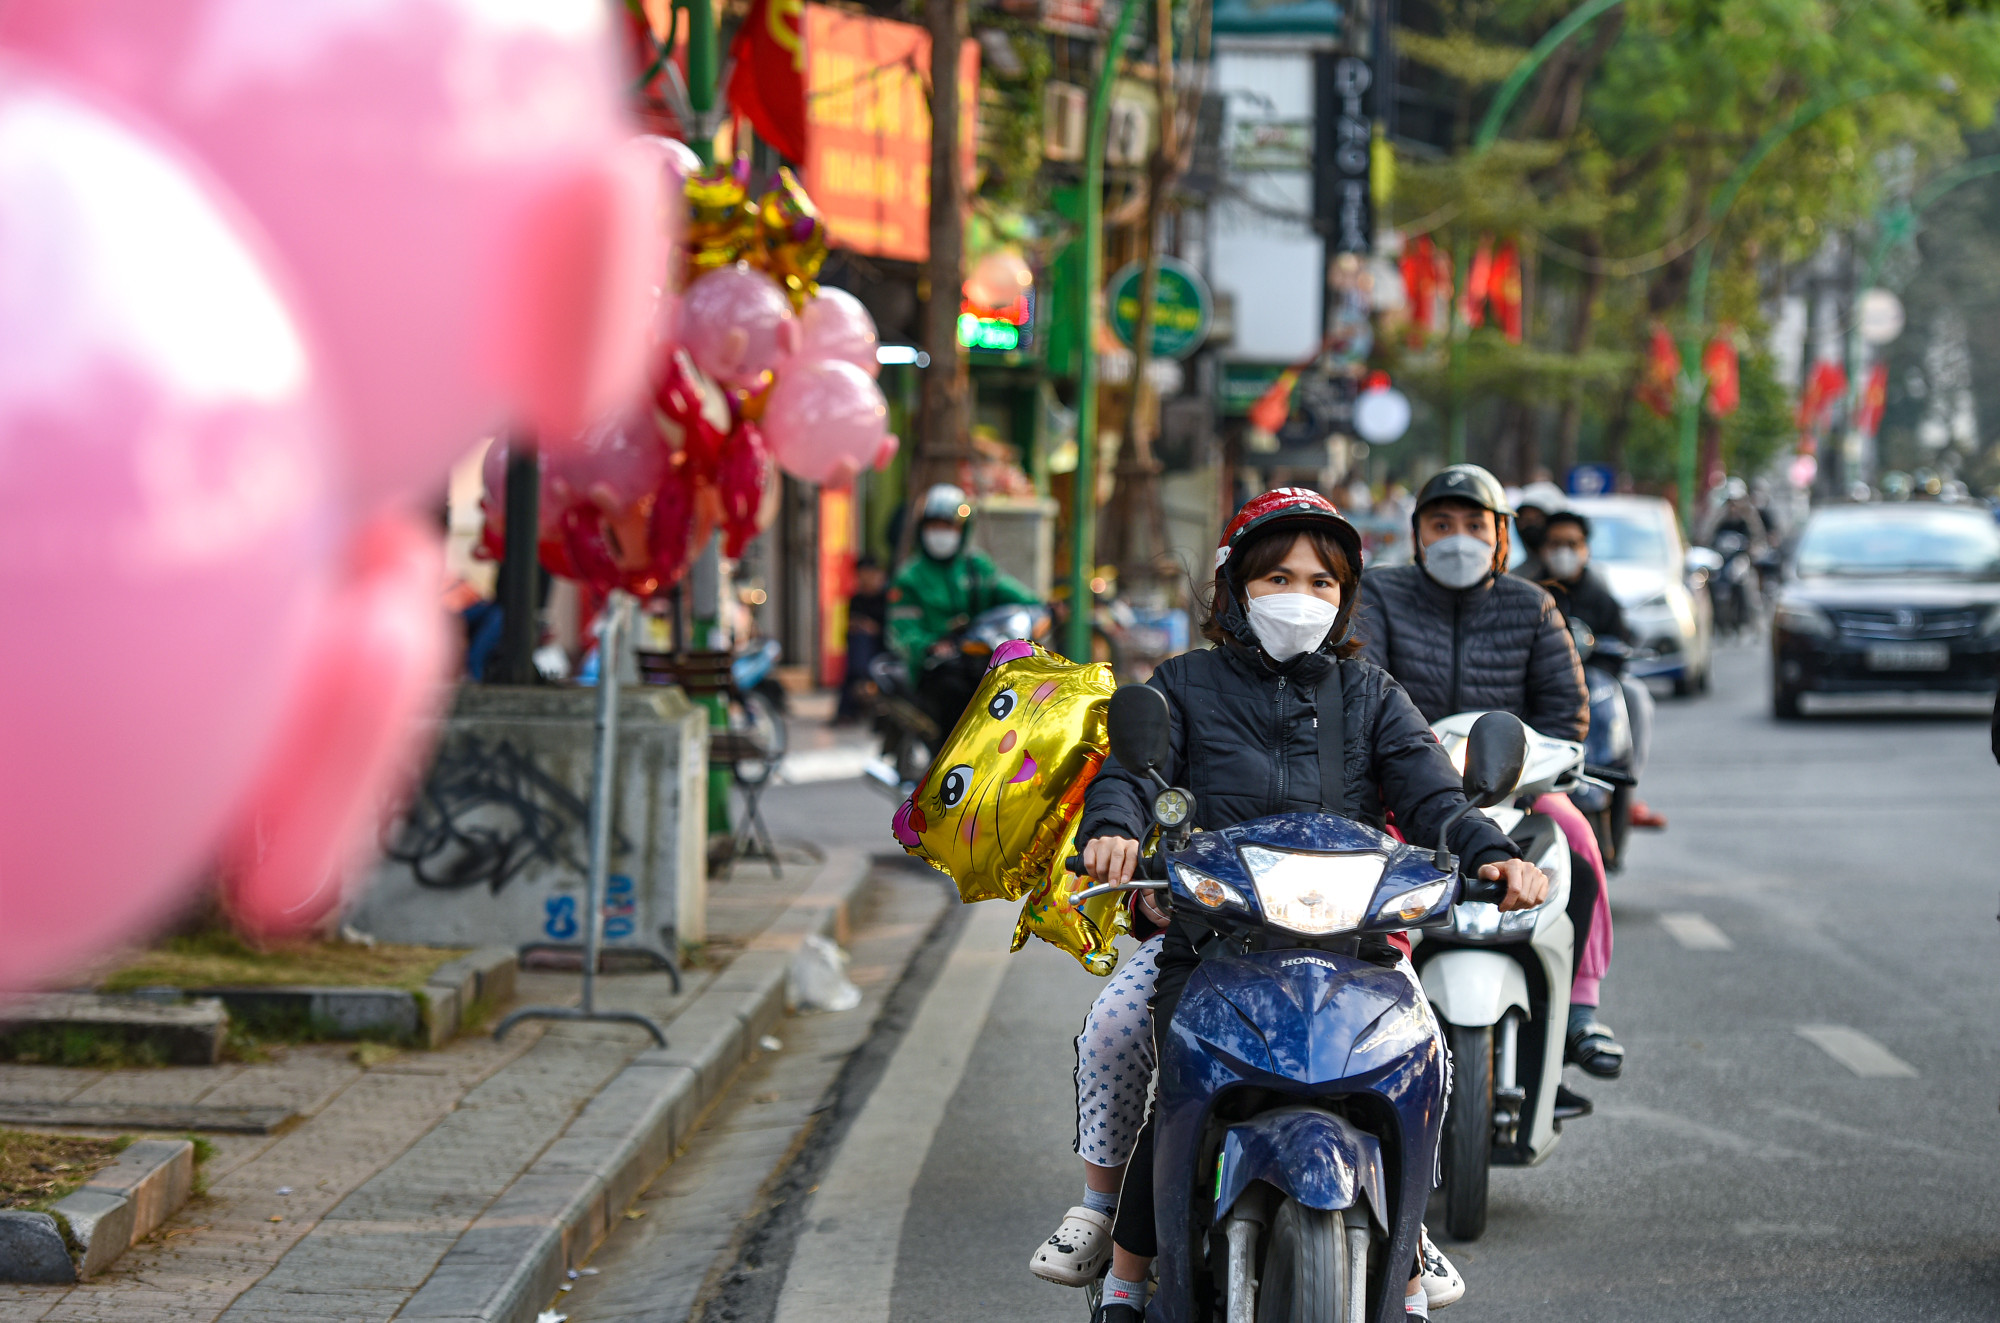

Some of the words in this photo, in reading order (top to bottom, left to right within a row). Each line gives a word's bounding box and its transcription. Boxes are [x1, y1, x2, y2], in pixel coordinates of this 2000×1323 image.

[1334, 57, 1373, 175] DING
[1335, 178, 1371, 252] TEA
[1280, 956, 1338, 971] HONDA
